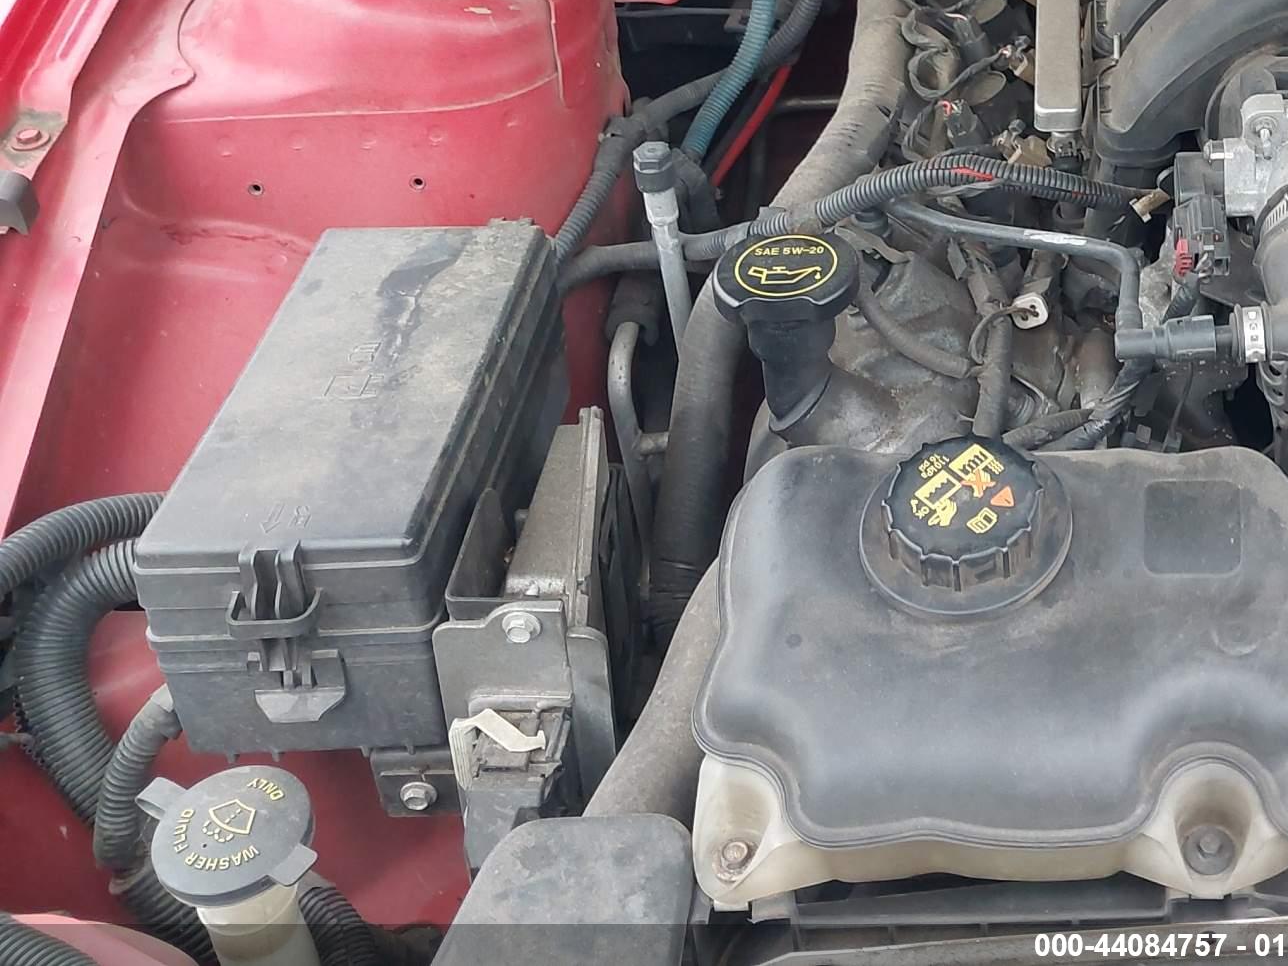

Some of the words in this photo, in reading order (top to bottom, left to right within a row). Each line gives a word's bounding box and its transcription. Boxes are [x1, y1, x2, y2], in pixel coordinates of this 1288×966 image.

[754, 247, 780, 256] SAE
[782, 245, 825, 255] 5W-20
[247, 777, 285, 801] ONLY
[174, 809, 195, 853] FLUID
[185, 845, 260, 871] WASHER
